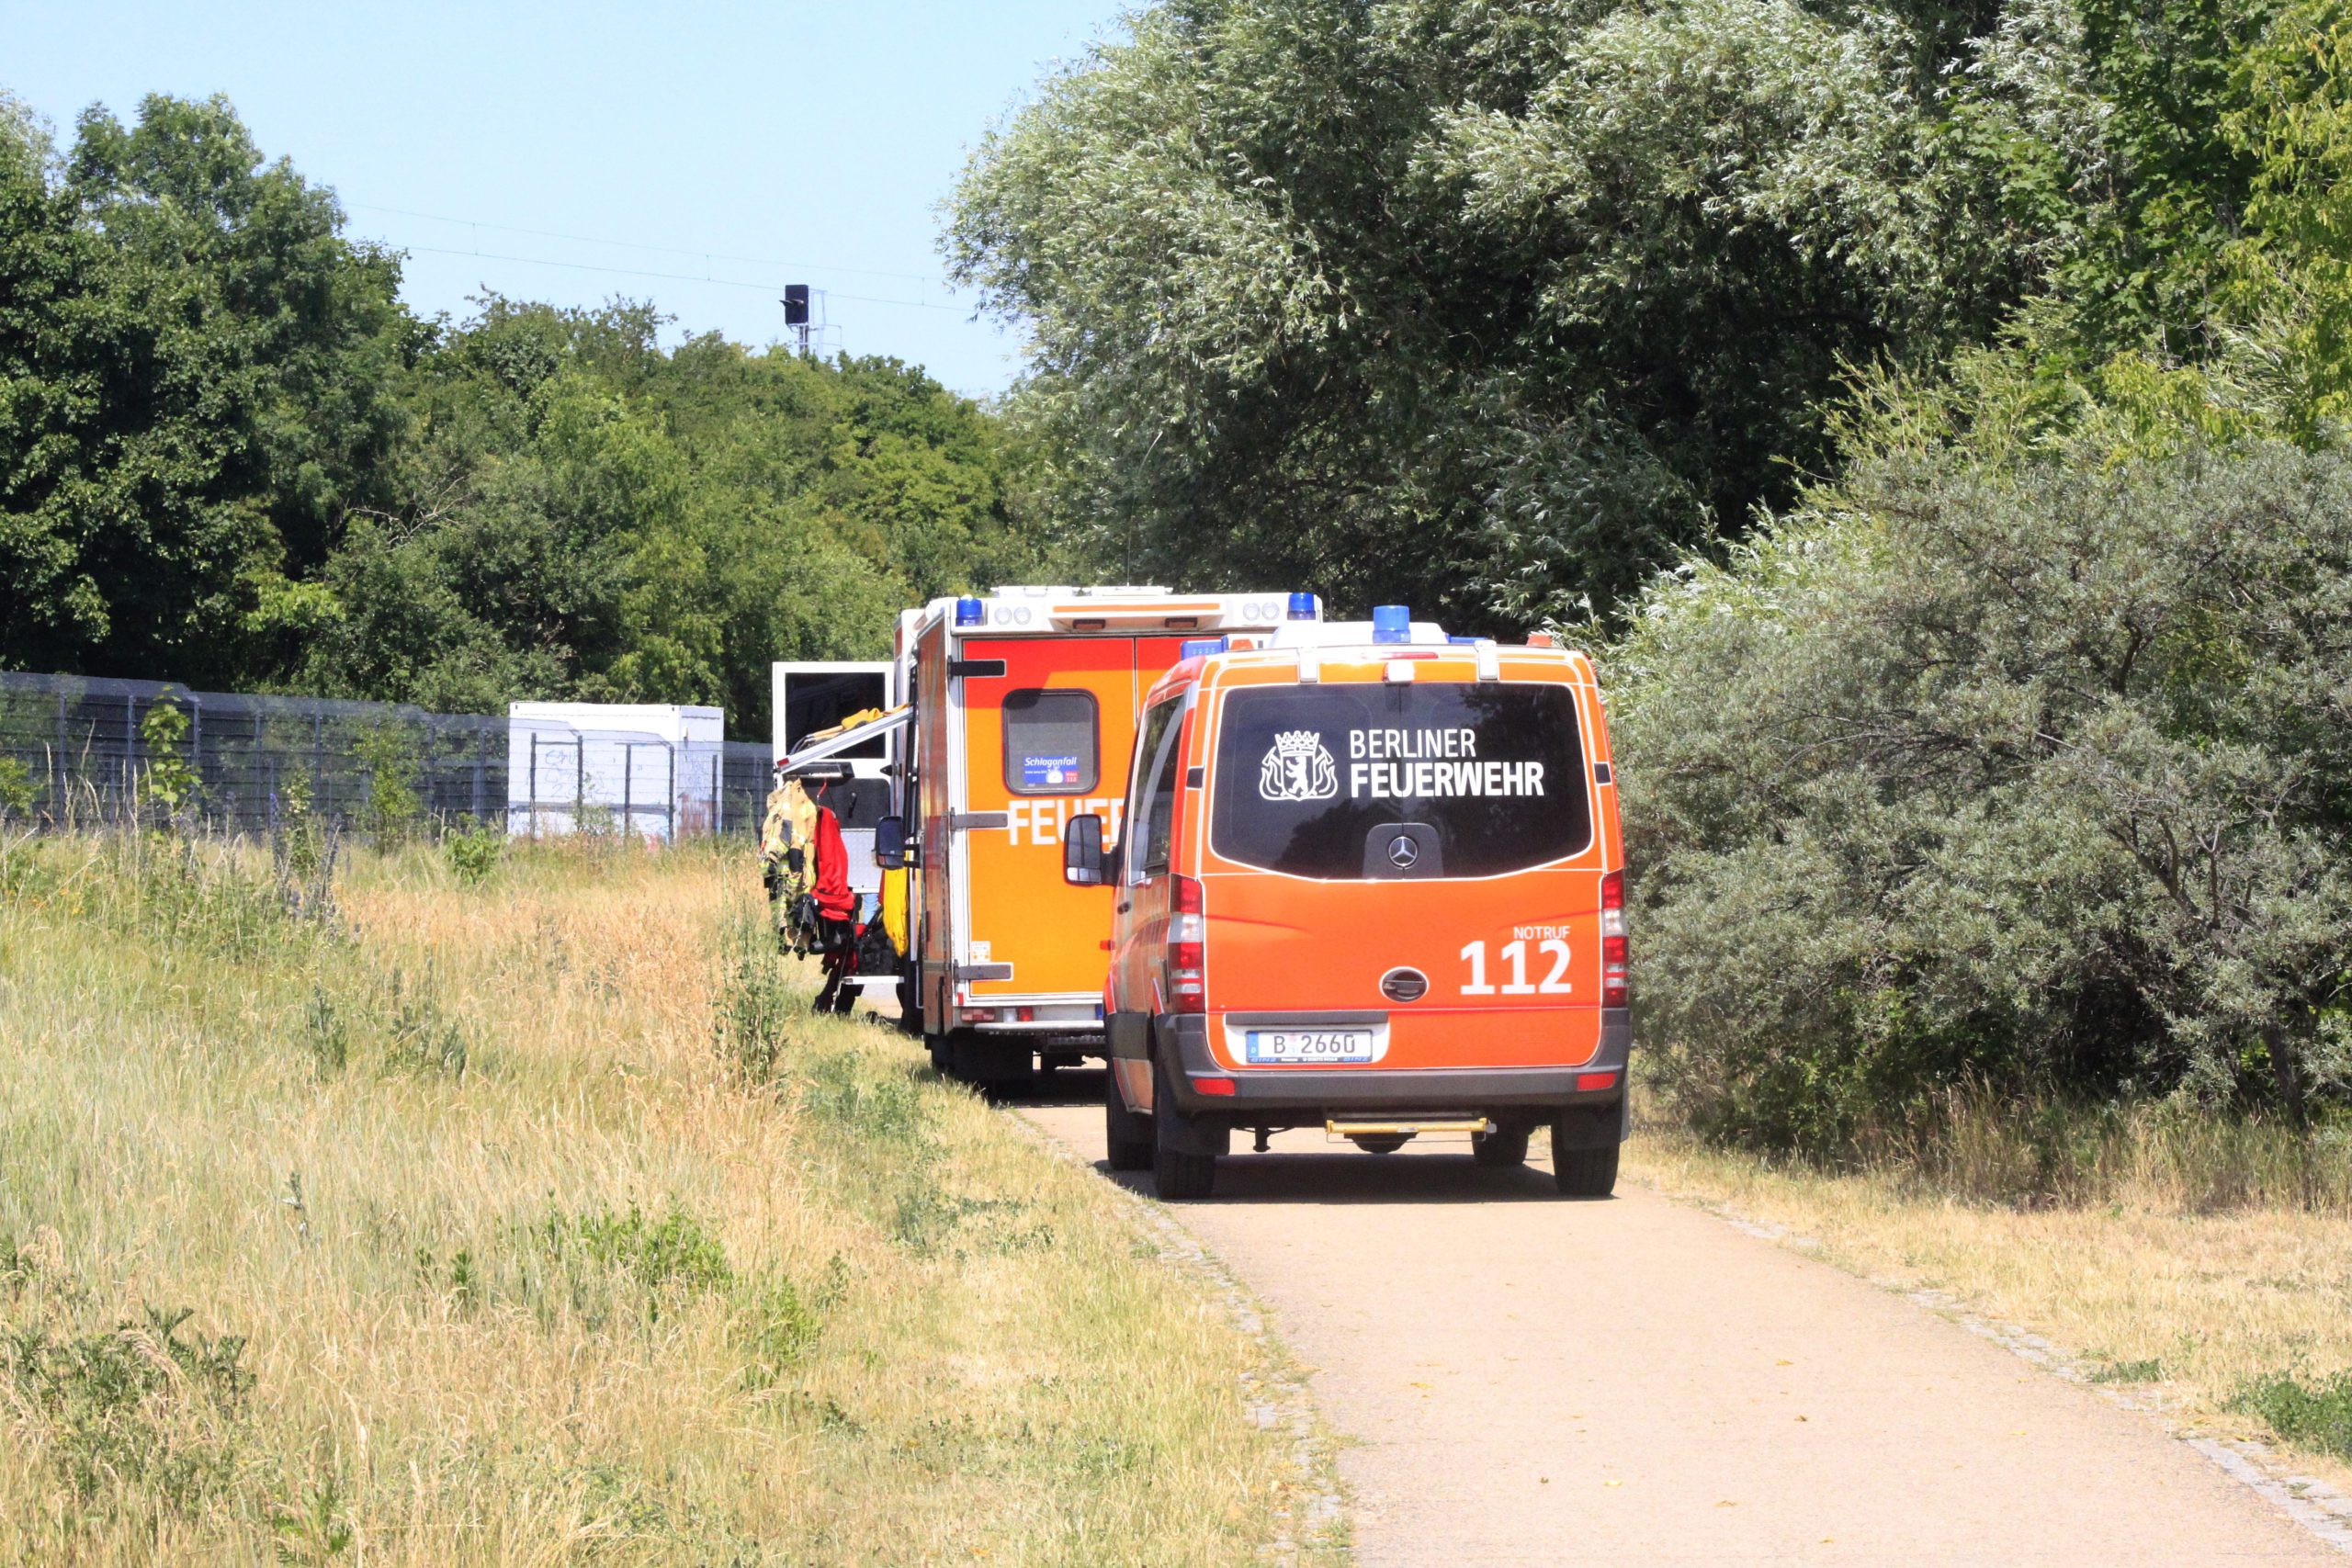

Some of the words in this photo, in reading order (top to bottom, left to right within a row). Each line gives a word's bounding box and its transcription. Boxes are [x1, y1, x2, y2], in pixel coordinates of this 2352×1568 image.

[1350, 728, 1476, 759] BERLINER
[1024, 756, 1077, 769] Schlaganfall
[1351, 761, 1544, 798] FEUERWEHR
[1513, 925, 1570, 940] NOTRUF
[1460, 939, 1572, 995] 112
[1273, 1035, 1286, 1054] B
[1301, 1034, 1355, 1054] 2660
